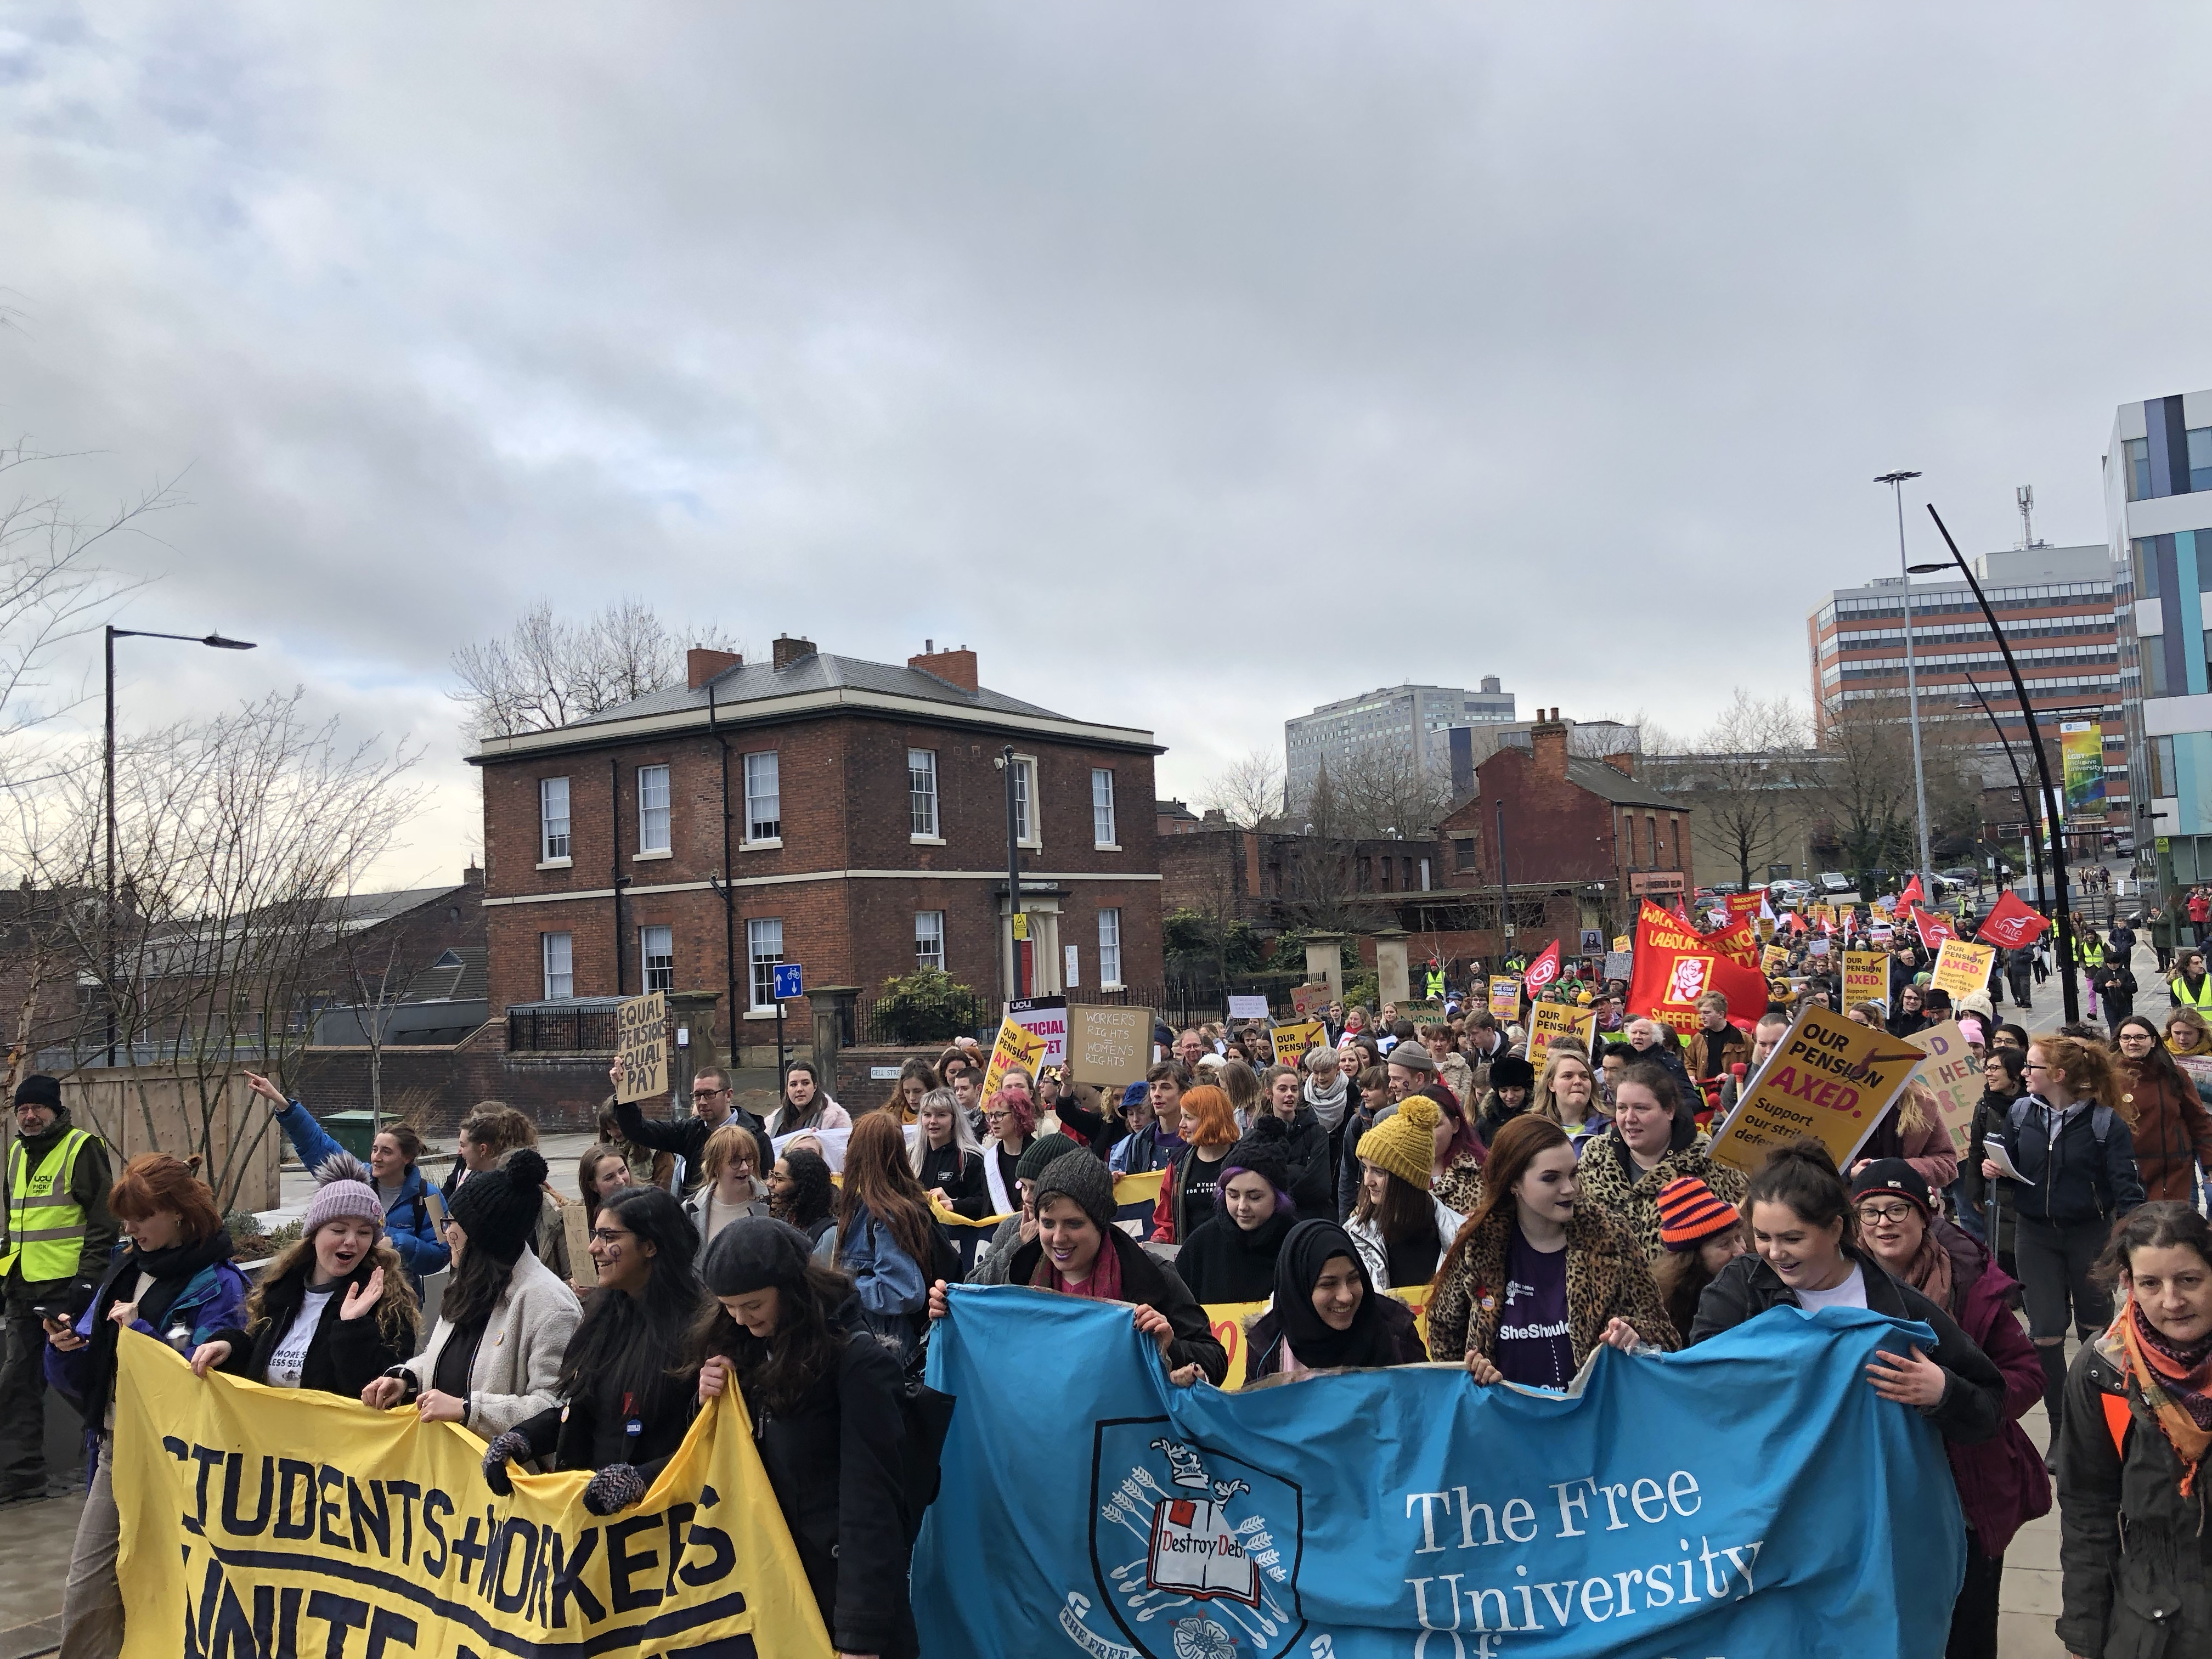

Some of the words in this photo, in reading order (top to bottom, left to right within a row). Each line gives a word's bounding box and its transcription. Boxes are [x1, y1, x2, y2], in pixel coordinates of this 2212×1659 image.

[1944, 950, 1984, 965] PENSION
[1940, 970, 1965, 979] Support
[1942, 959, 1982, 976] AXED.
[1846, 974, 1883, 985] AXED.
[1294, 988, 1307, 997] NO
[618, 998, 662, 1029] EQUAL
[1407, 1001, 1440, 1012] BEING
[1085, 1011, 1136, 1027] WORKER'S
[1410, 1014, 1444, 1025] WOMAN
[1538, 1010, 1560, 1021] OUR
[1649, 1008, 1705, 1030] SHEFFIE
[618, 1017, 667, 1052] PENSIONS
[1003, 1027, 1017, 1043] OUR
[1536, 1019, 1584, 1036] PENSION
[1277, 1034, 1295, 1043] OUR
[1278, 1040, 1319, 1053] PENSION
[1803, 1023, 1849, 1053] OUR
[998, 1037, 1034, 1066] PENSION
[1087, 1042, 1135, 1056] WOMEN'S
[1788, 1040, 1884, 1089] PENSION
[628, 1064, 658, 1096] PAY
[1767, 1065, 1861, 1118] AXED.
[1937, 1085, 1971, 1113] BE
[1754, 1097, 1814, 1127] Support
[1745, 1114, 1771, 1130] our
[275, 1350, 300, 1358] MORE
[1406, 1486, 1538, 1555] The
[1548, 1470, 1702, 1538] Free
[1163, 1530, 1217, 1560] Destroy
[1404, 1536, 1764, 1633] University
[1063, 1609, 1088, 1643] THE
